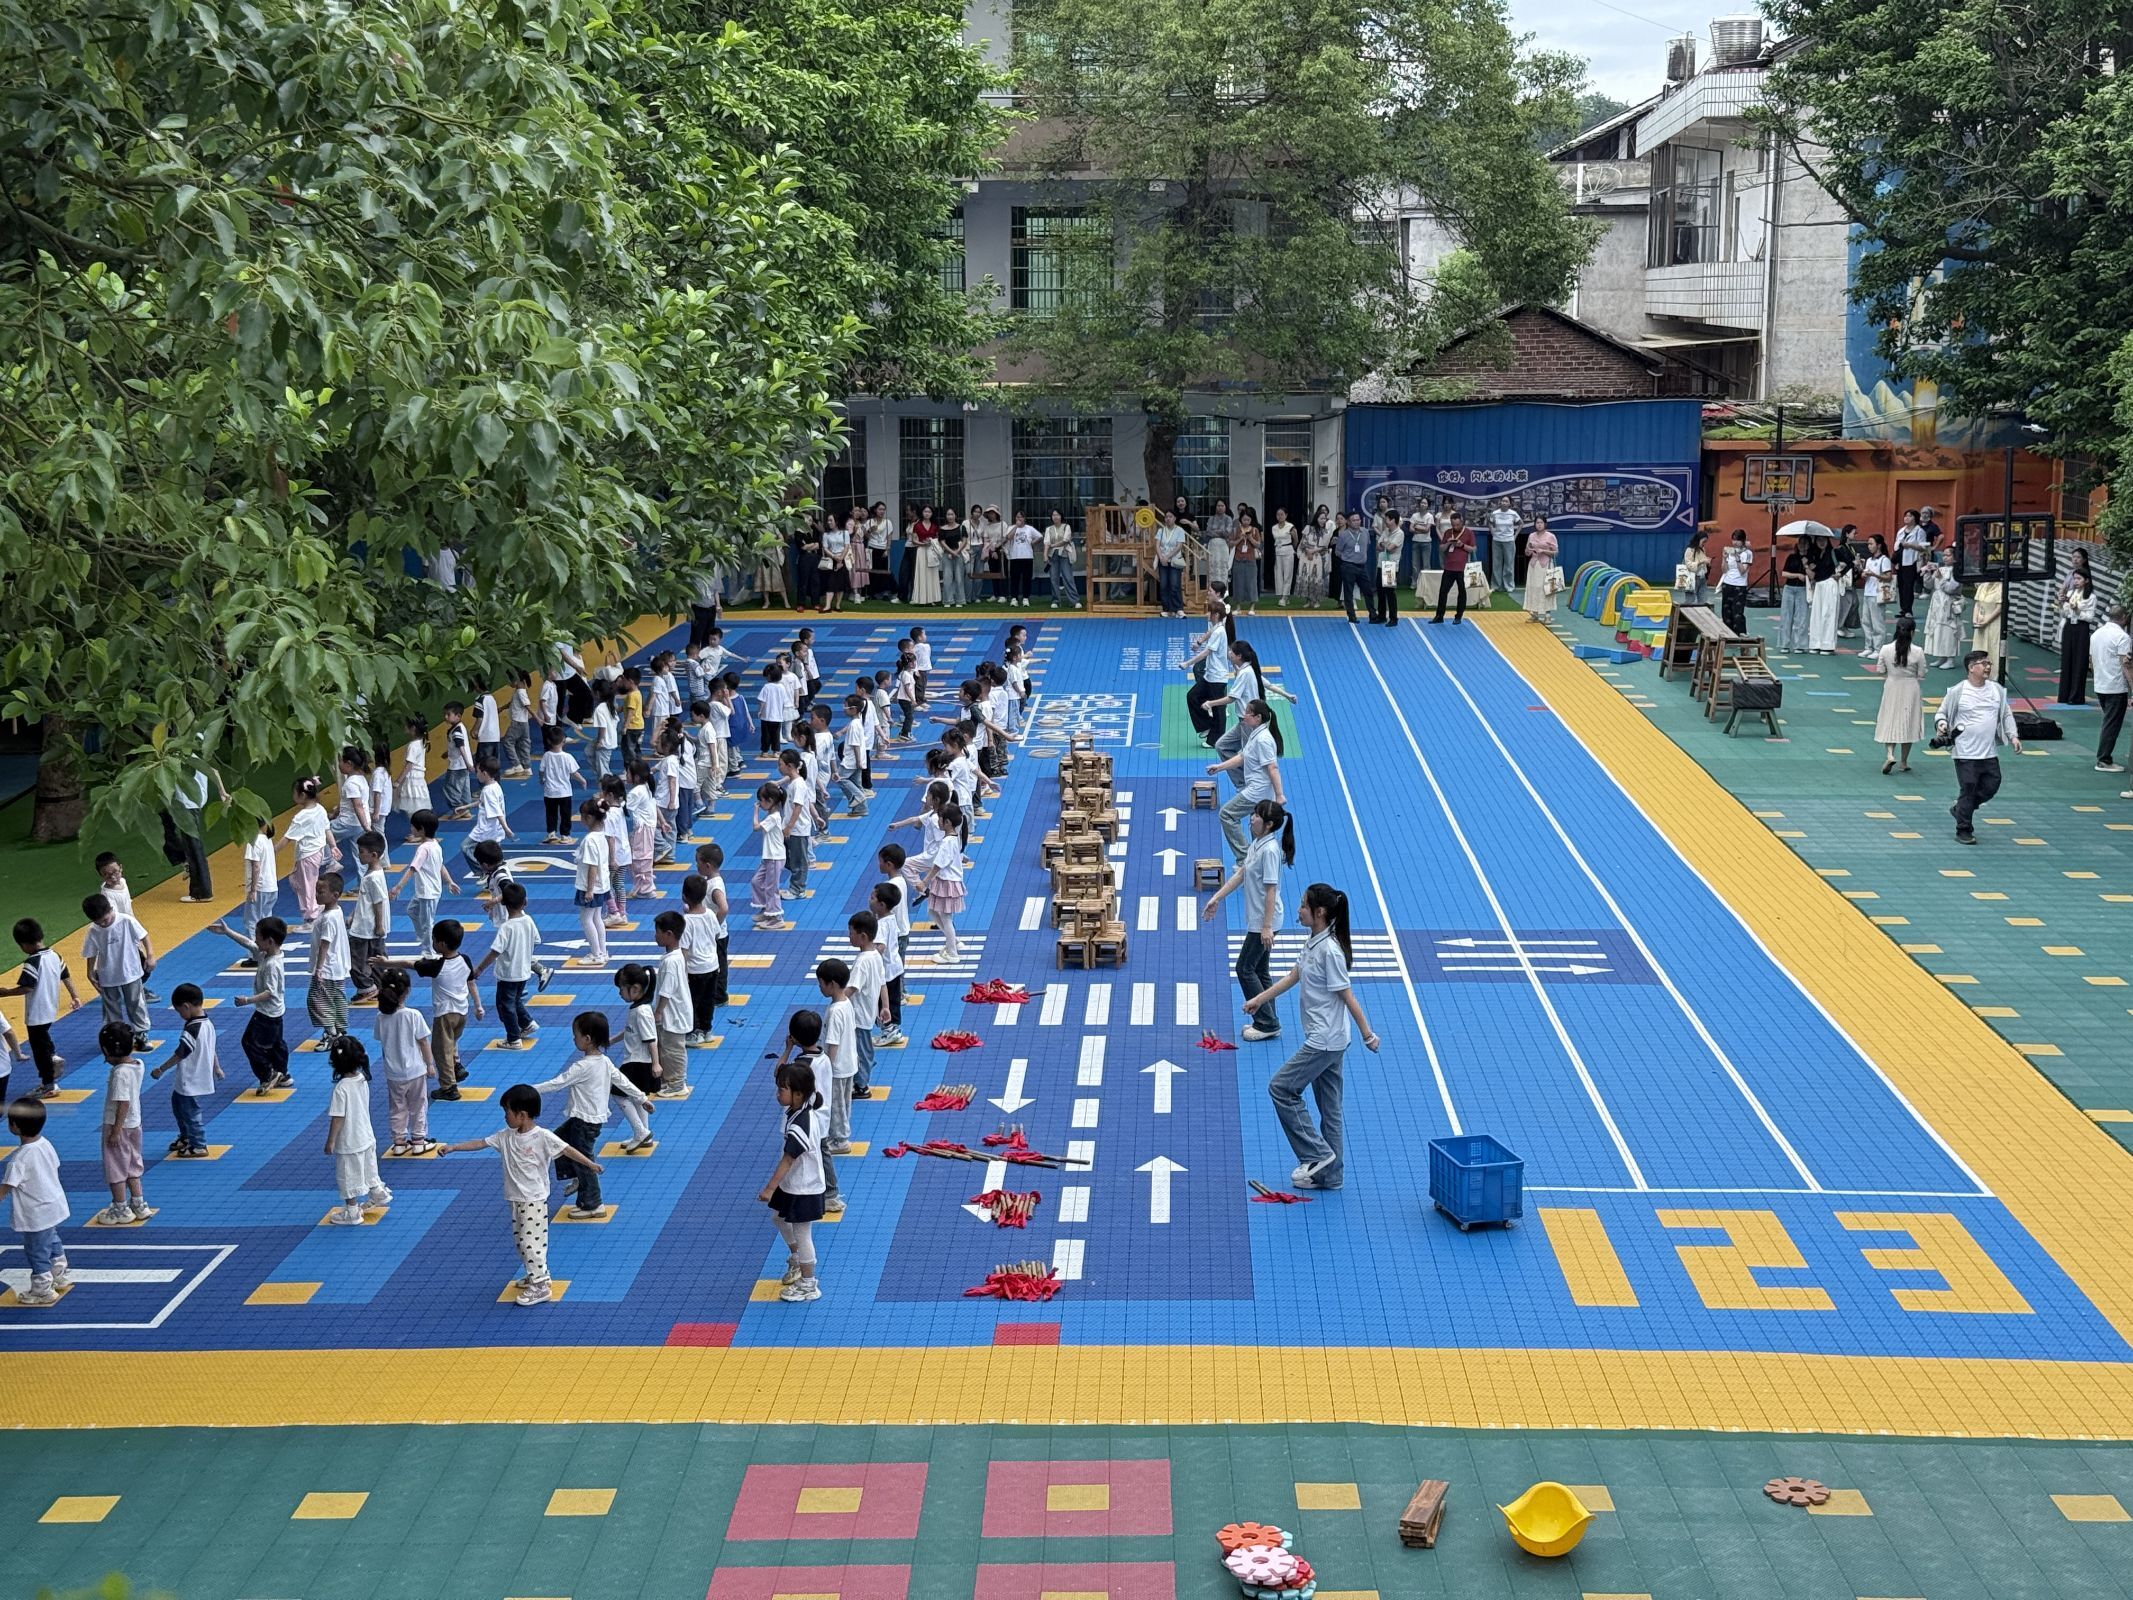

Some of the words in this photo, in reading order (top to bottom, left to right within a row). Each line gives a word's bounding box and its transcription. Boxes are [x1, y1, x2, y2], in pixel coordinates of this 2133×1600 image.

[1064, 722, 1095, 730] 4
[1537, 1207, 1640, 1307] 1
[1655, 1209, 1837, 1310] 2
[1833, 1211, 2036, 1315] 3
